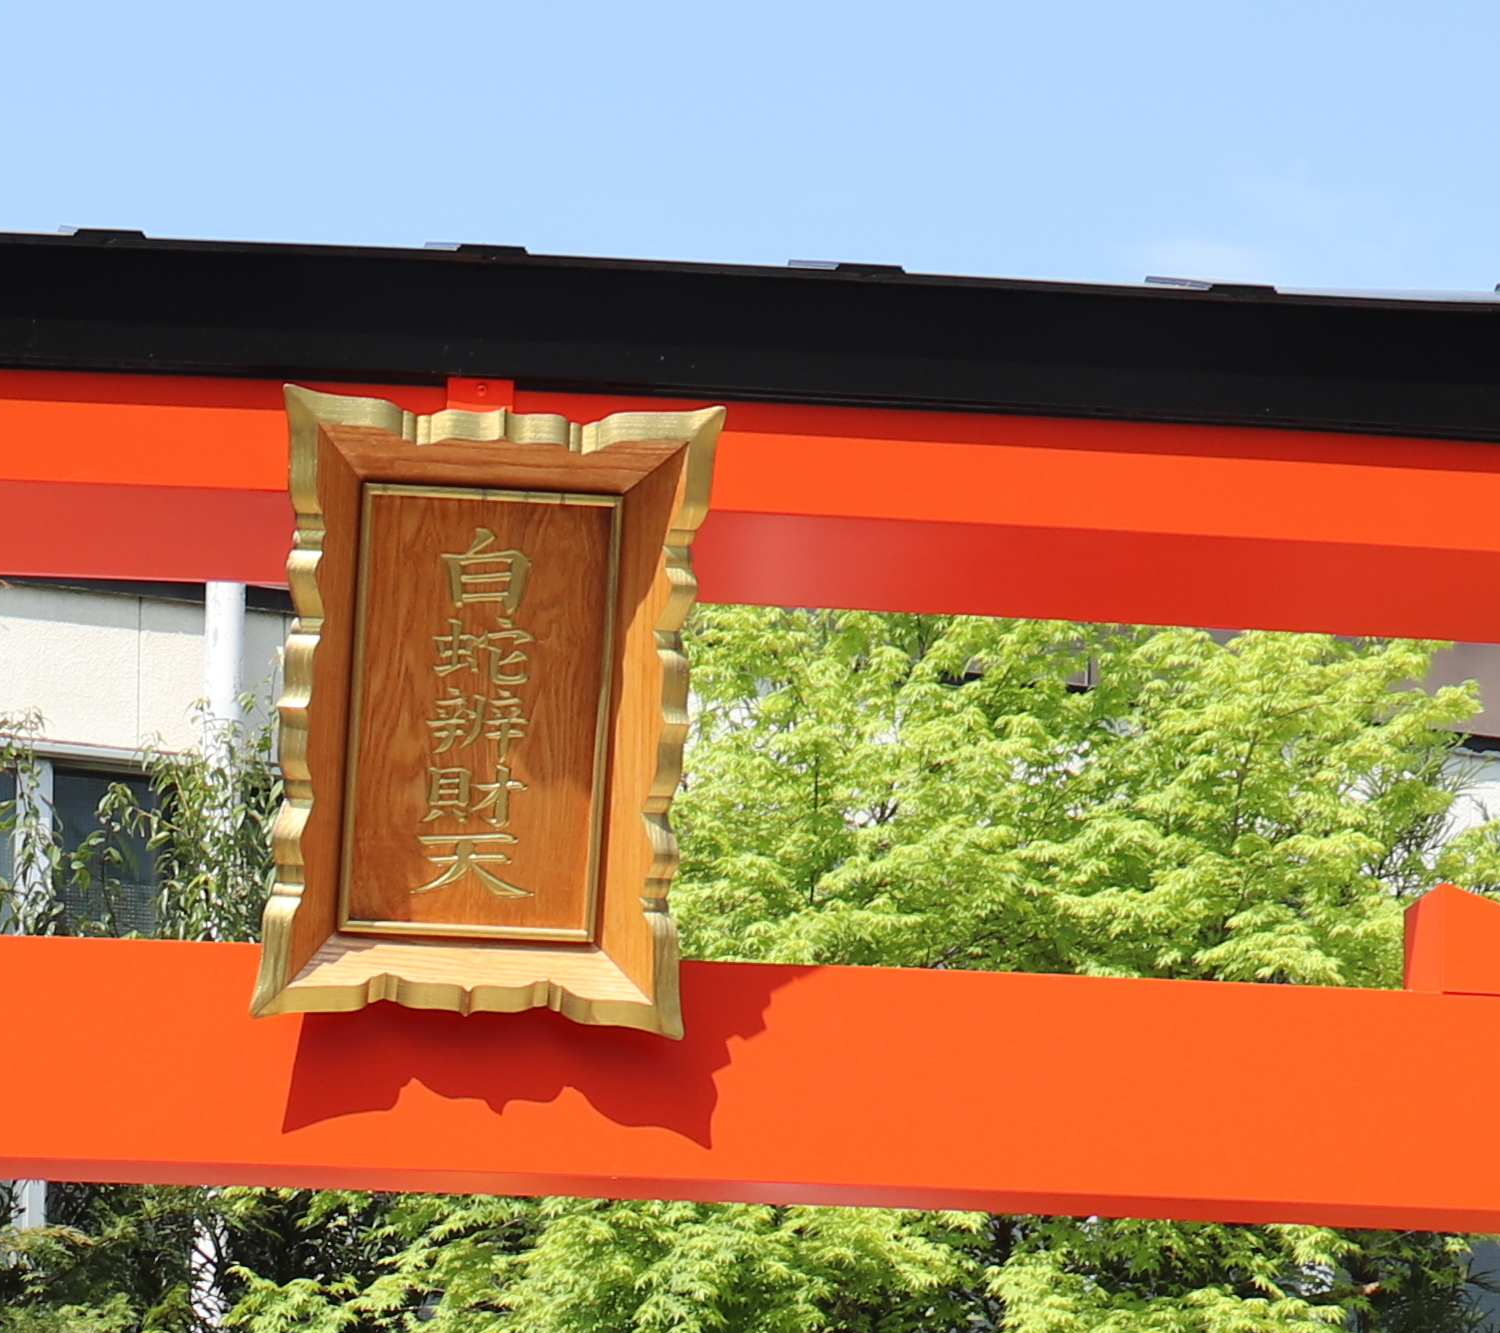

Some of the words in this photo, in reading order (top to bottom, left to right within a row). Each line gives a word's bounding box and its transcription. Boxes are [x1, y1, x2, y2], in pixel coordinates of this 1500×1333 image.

[410, 527, 534, 897] 白蛇辨財天
